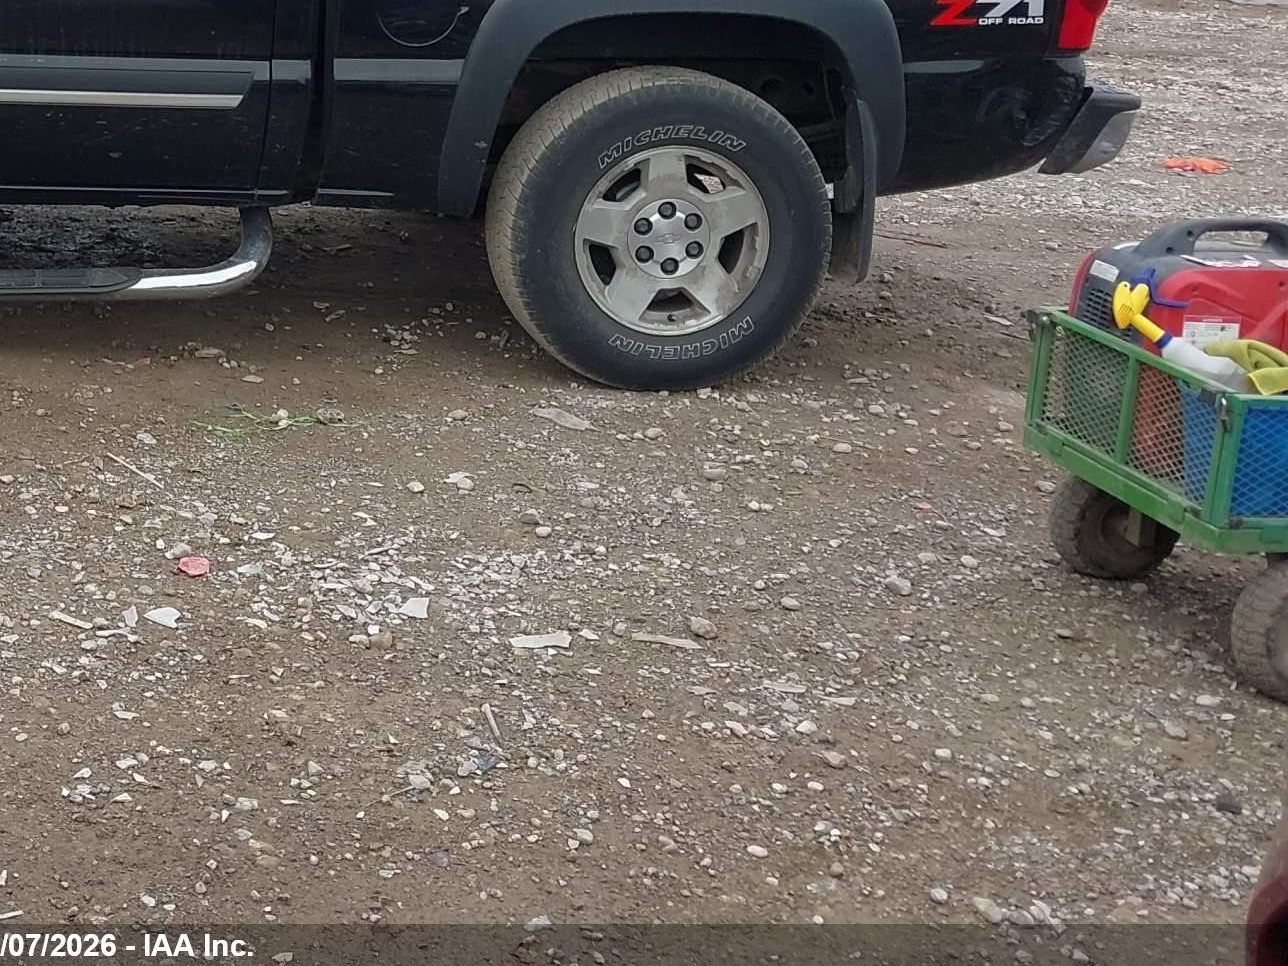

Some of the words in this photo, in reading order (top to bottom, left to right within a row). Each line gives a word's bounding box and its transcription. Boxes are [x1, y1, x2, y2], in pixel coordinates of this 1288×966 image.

[978, 17, 1003, 25] OFF
[597, 125, 747, 169] MICHELIN
[608, 316, 755, 360] MICHELIN
